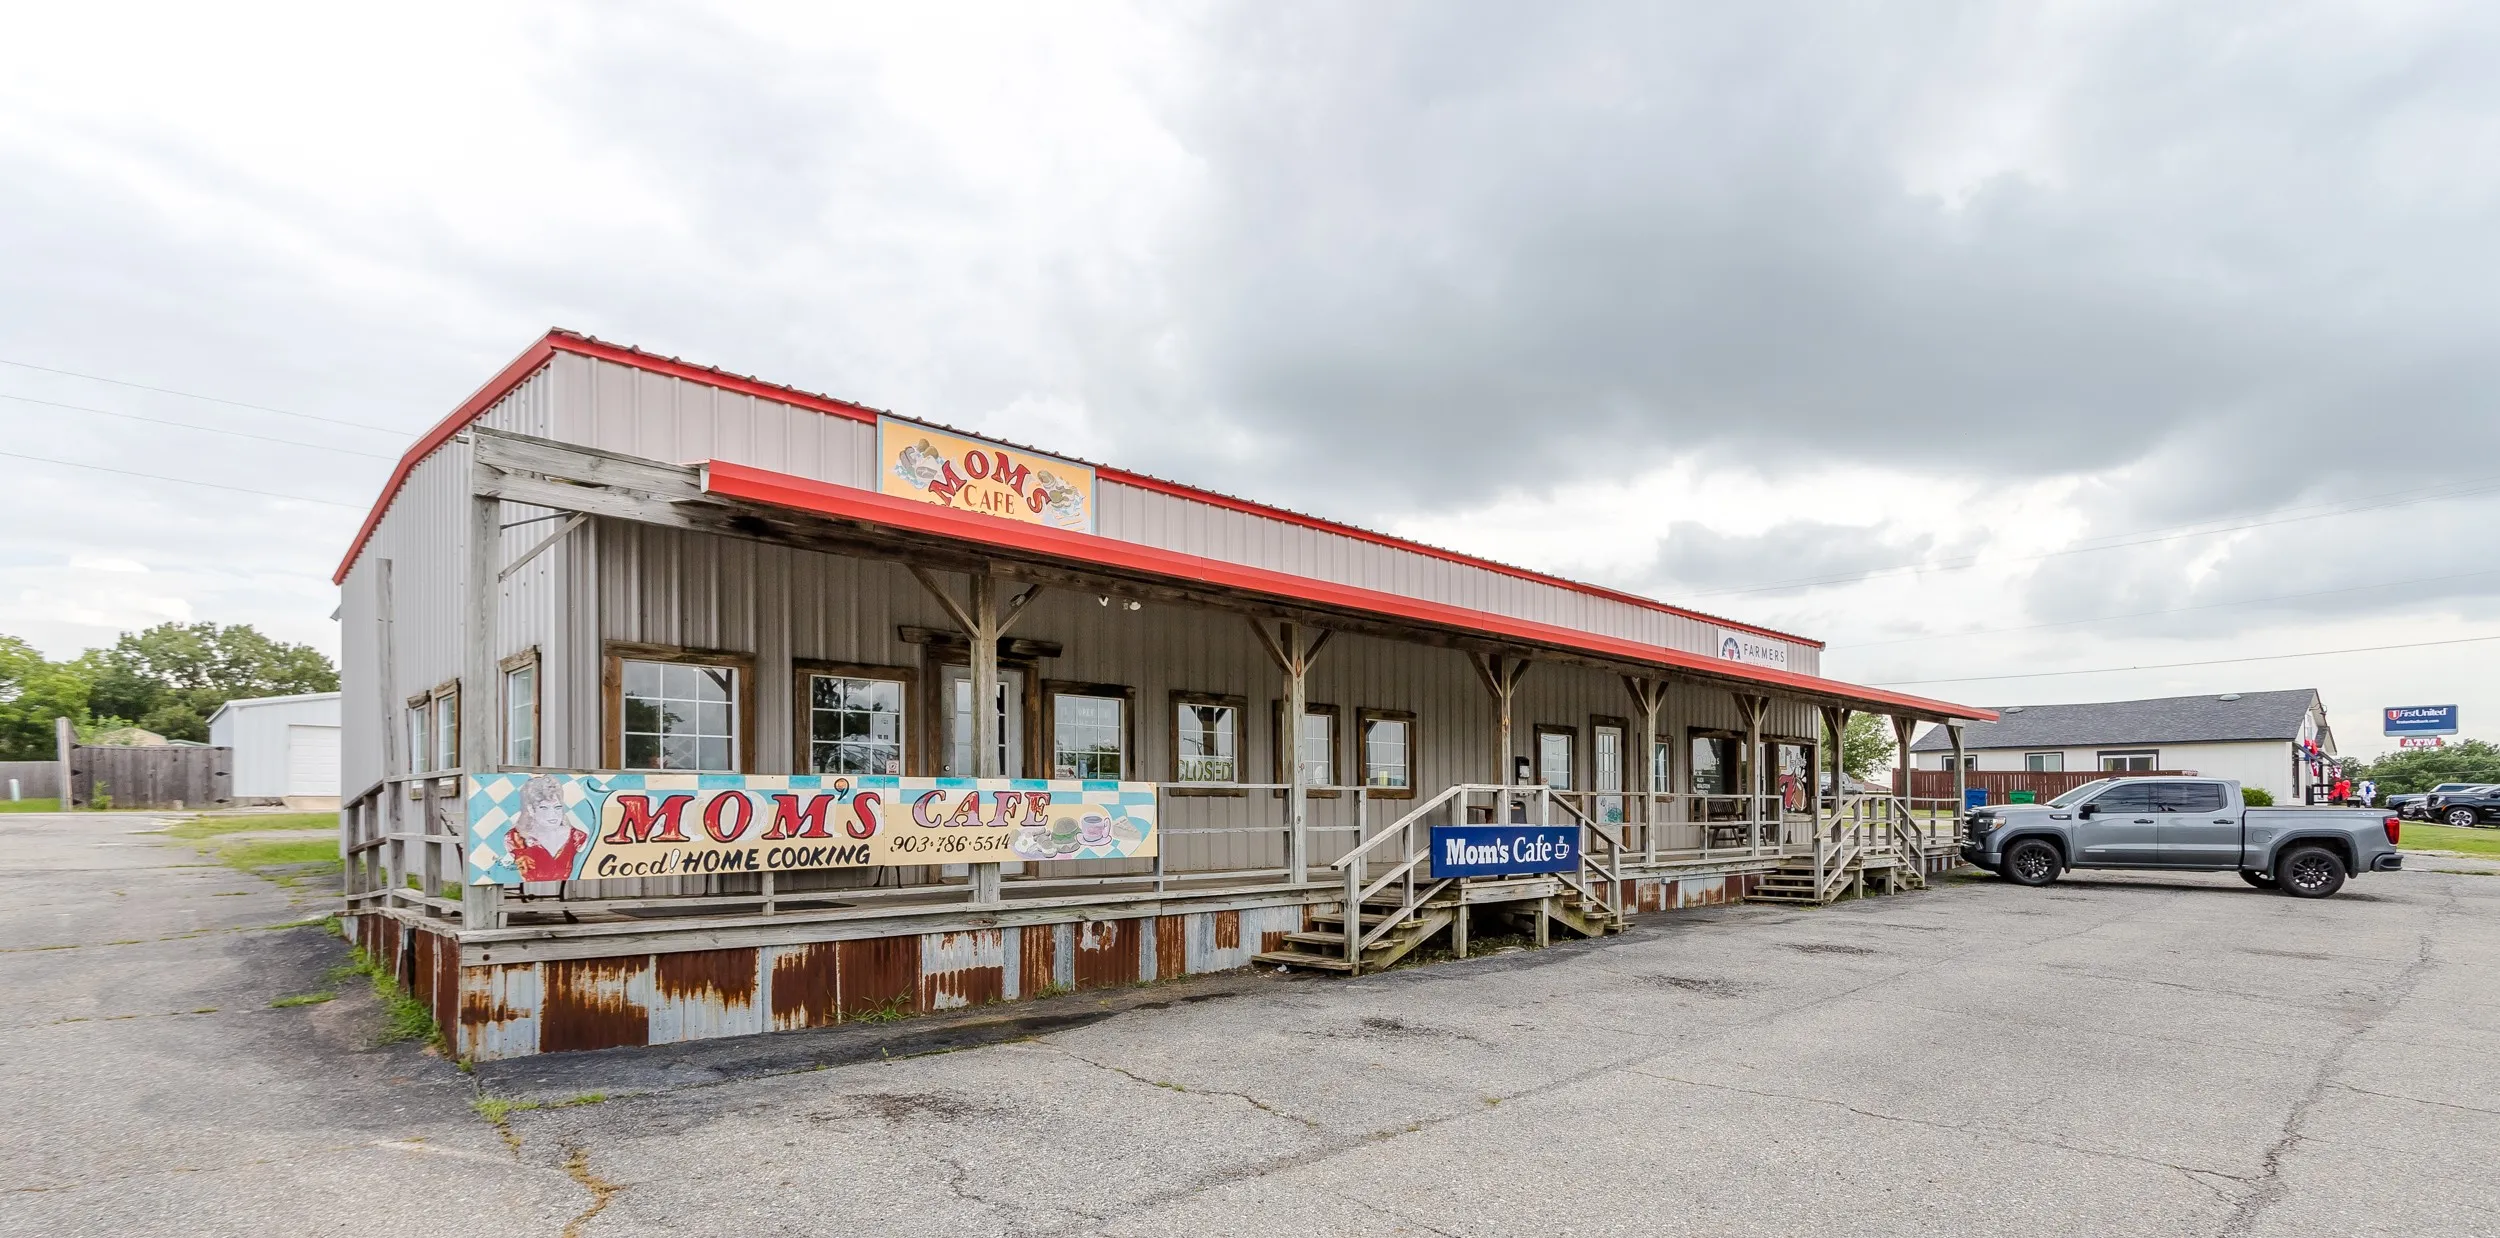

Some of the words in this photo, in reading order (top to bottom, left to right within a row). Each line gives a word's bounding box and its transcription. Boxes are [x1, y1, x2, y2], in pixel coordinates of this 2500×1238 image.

[963, 484, 1015, 515] CAFE
[1743, 643, 1785, 663] FARMERS
[2403, 738, 2438, 747] ATM
[1179, 760, 1233, 782] CLOSED
[603, 777, 881, 844] MOM'S
[912, 789, 1051, 829] CAFE
[681, 847, 760, 874] HOME
[767, 843, 871, 869] COOKING
[1446, 837, 1509, 866] Mom's
[1513, 834, 1552, 863] Cafe
